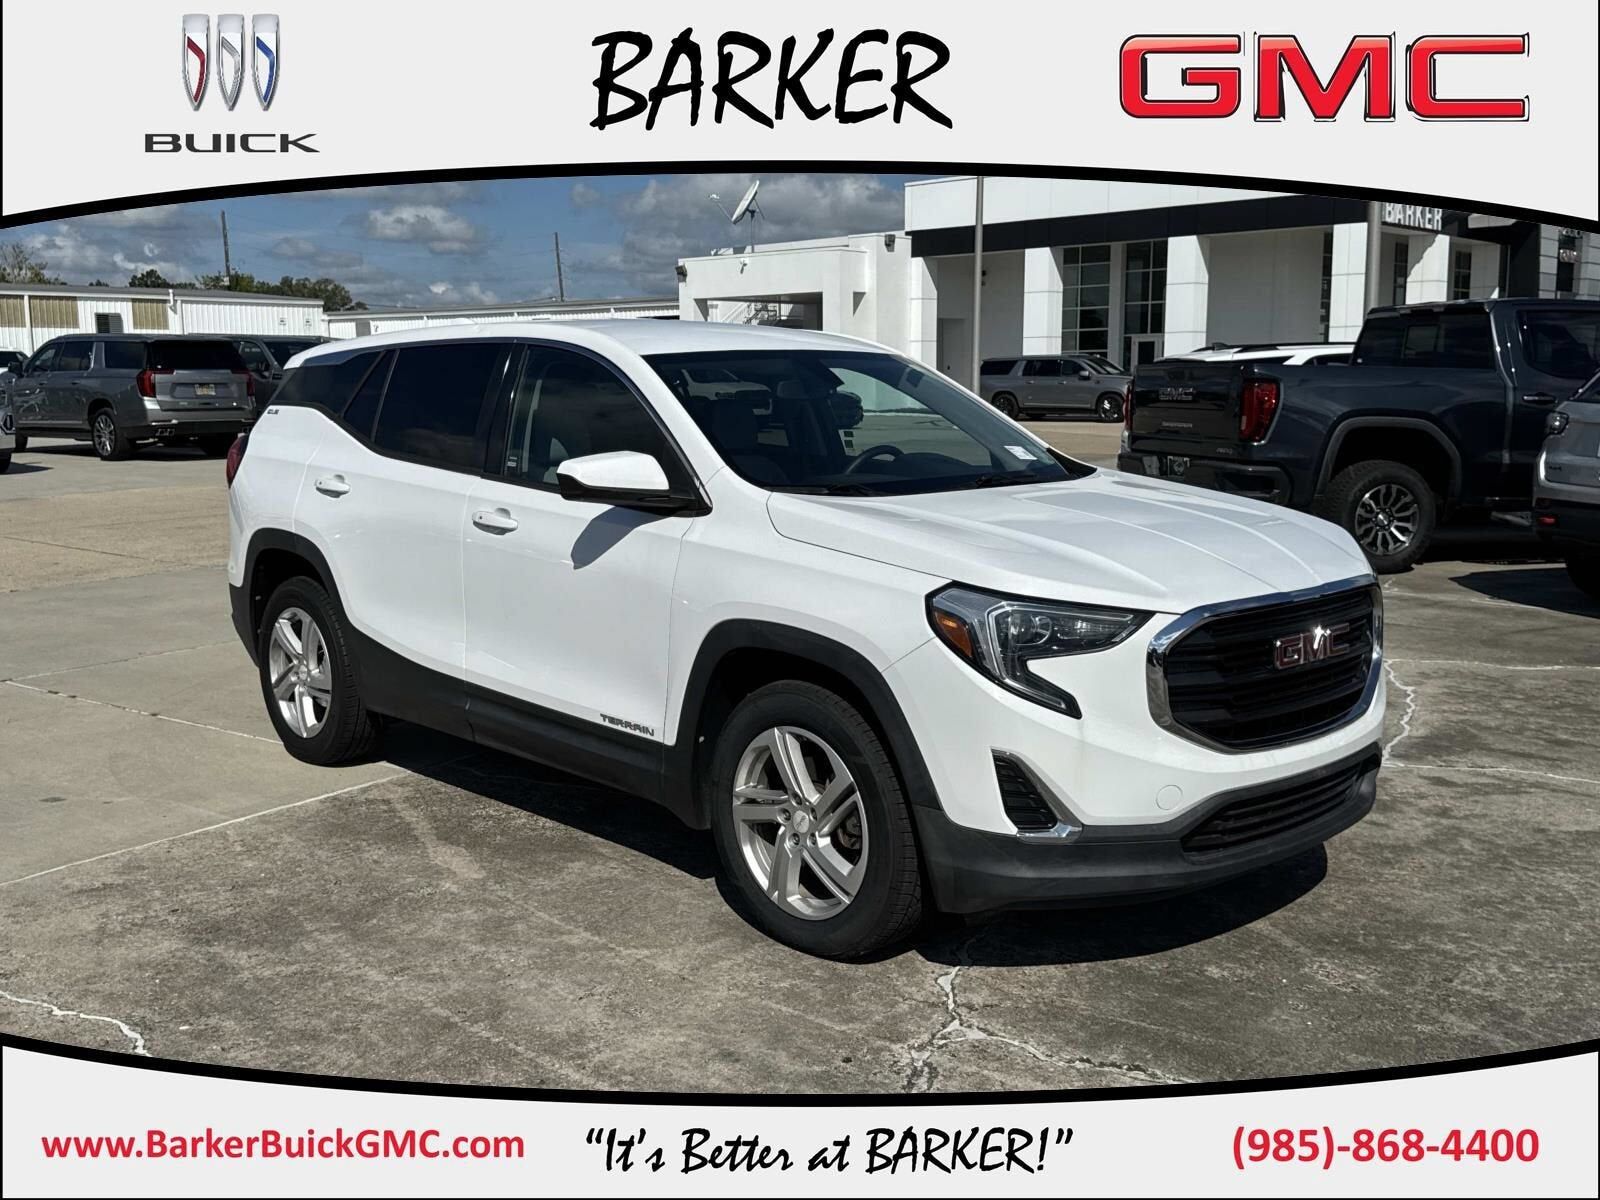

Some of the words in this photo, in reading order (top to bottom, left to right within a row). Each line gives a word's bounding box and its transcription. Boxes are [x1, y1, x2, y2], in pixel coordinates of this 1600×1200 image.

[1385, 202, 1442, 231] BARKER
[1274, 622, 1350, 670] GMC
[599, 713, 655, 737] TERRAIN
